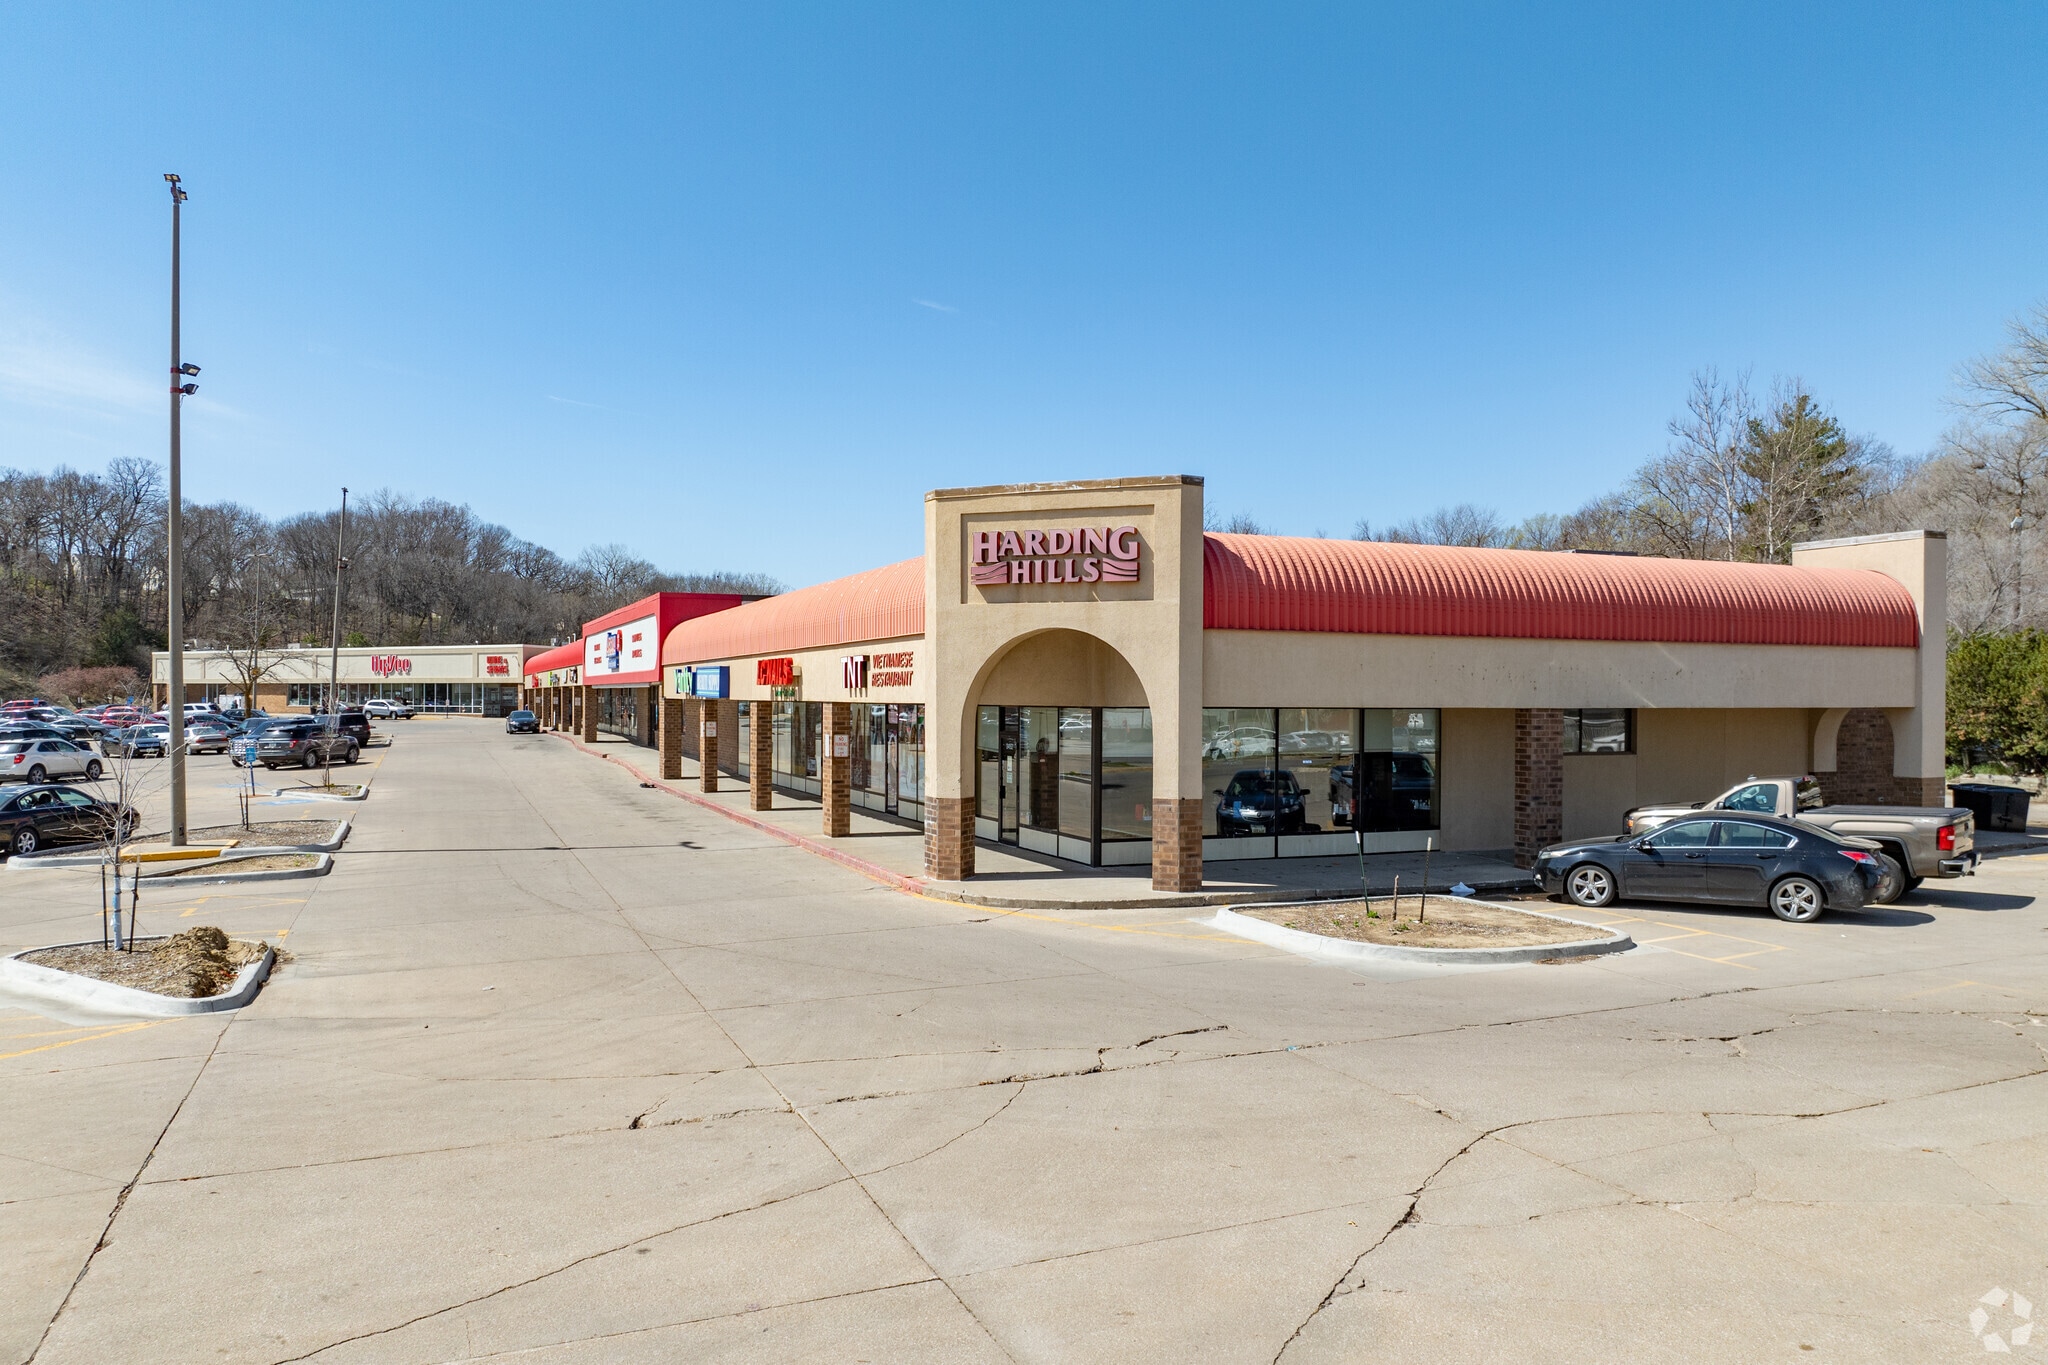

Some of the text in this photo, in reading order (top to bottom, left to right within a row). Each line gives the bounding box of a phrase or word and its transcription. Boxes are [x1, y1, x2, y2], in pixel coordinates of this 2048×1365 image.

[972, 526, 1140, 563] HARDING
[1010, 558, 1102, 584] HILLS
[840, 655, 866, 689] TNT
[872, 651, 914, 669] VIETNAMESE
[871, 671, 914, 688] RESTAURANT
